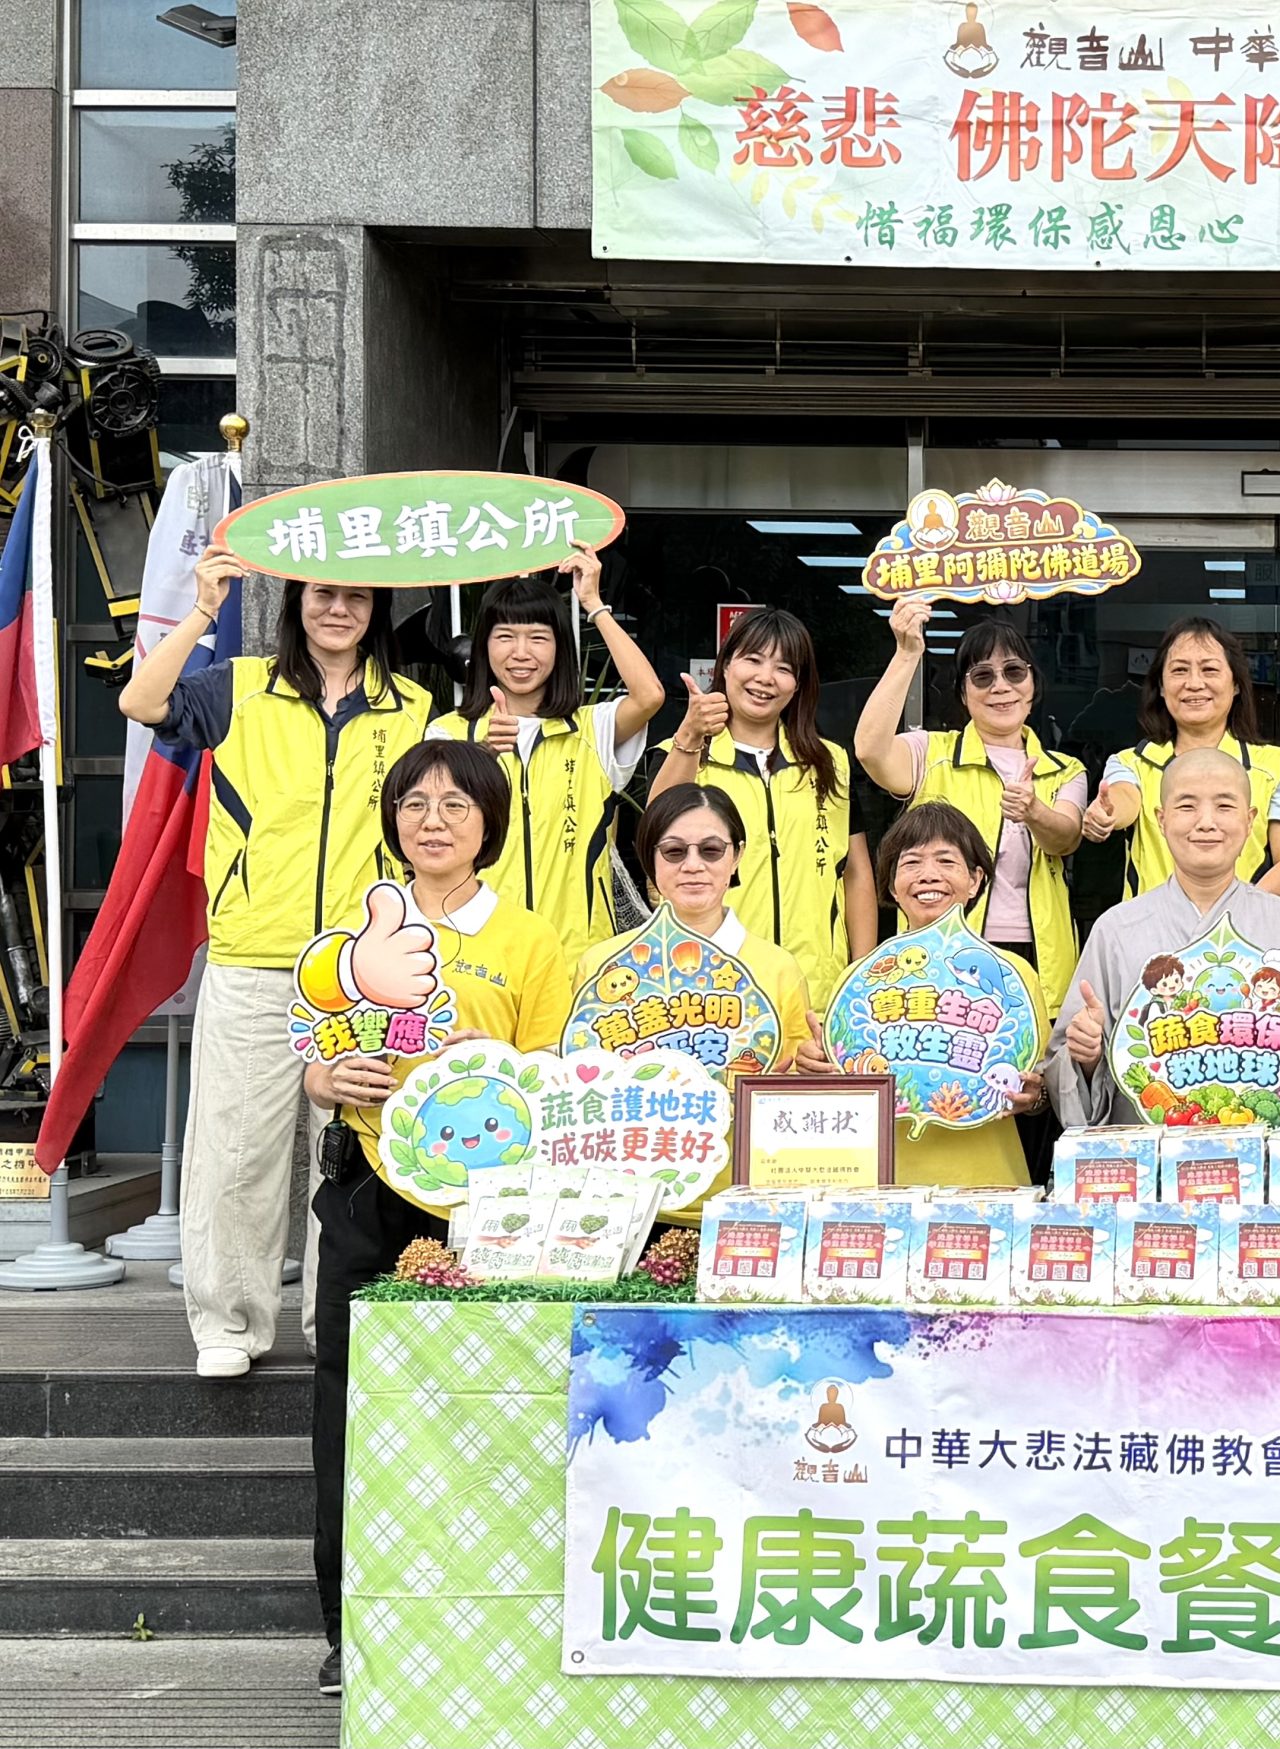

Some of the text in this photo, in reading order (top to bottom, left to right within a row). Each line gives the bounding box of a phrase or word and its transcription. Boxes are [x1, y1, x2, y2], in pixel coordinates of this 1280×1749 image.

[1020, 22, 1165, 72] 觀音山
[732, 85, 903, 171] 慈悲
[855, 199, 1246, 256] 惜福環保感恩心
[265, 497, 580, 563] 埔里鎮公所
[965, 508, 1065, 542] 觀音山
[875, 542, 1131, 590] 埔里阿彌陀佛道場
[313, 1008, 429, 1060] 我響應
[592, 990, 742, 1051] 萬盞光明
[869, 985, 1003, 1034] 尊重生命
[880, 1024, 989, 1073] 救生靈
[1165, 1047, 1280, 1089] 救地球
[540, 1086, 717, 1132] 蔬食護地球
[541, 1127, 716, 1167] 減碳更美好
[793, 1458, 869, 1484] 觀音山
